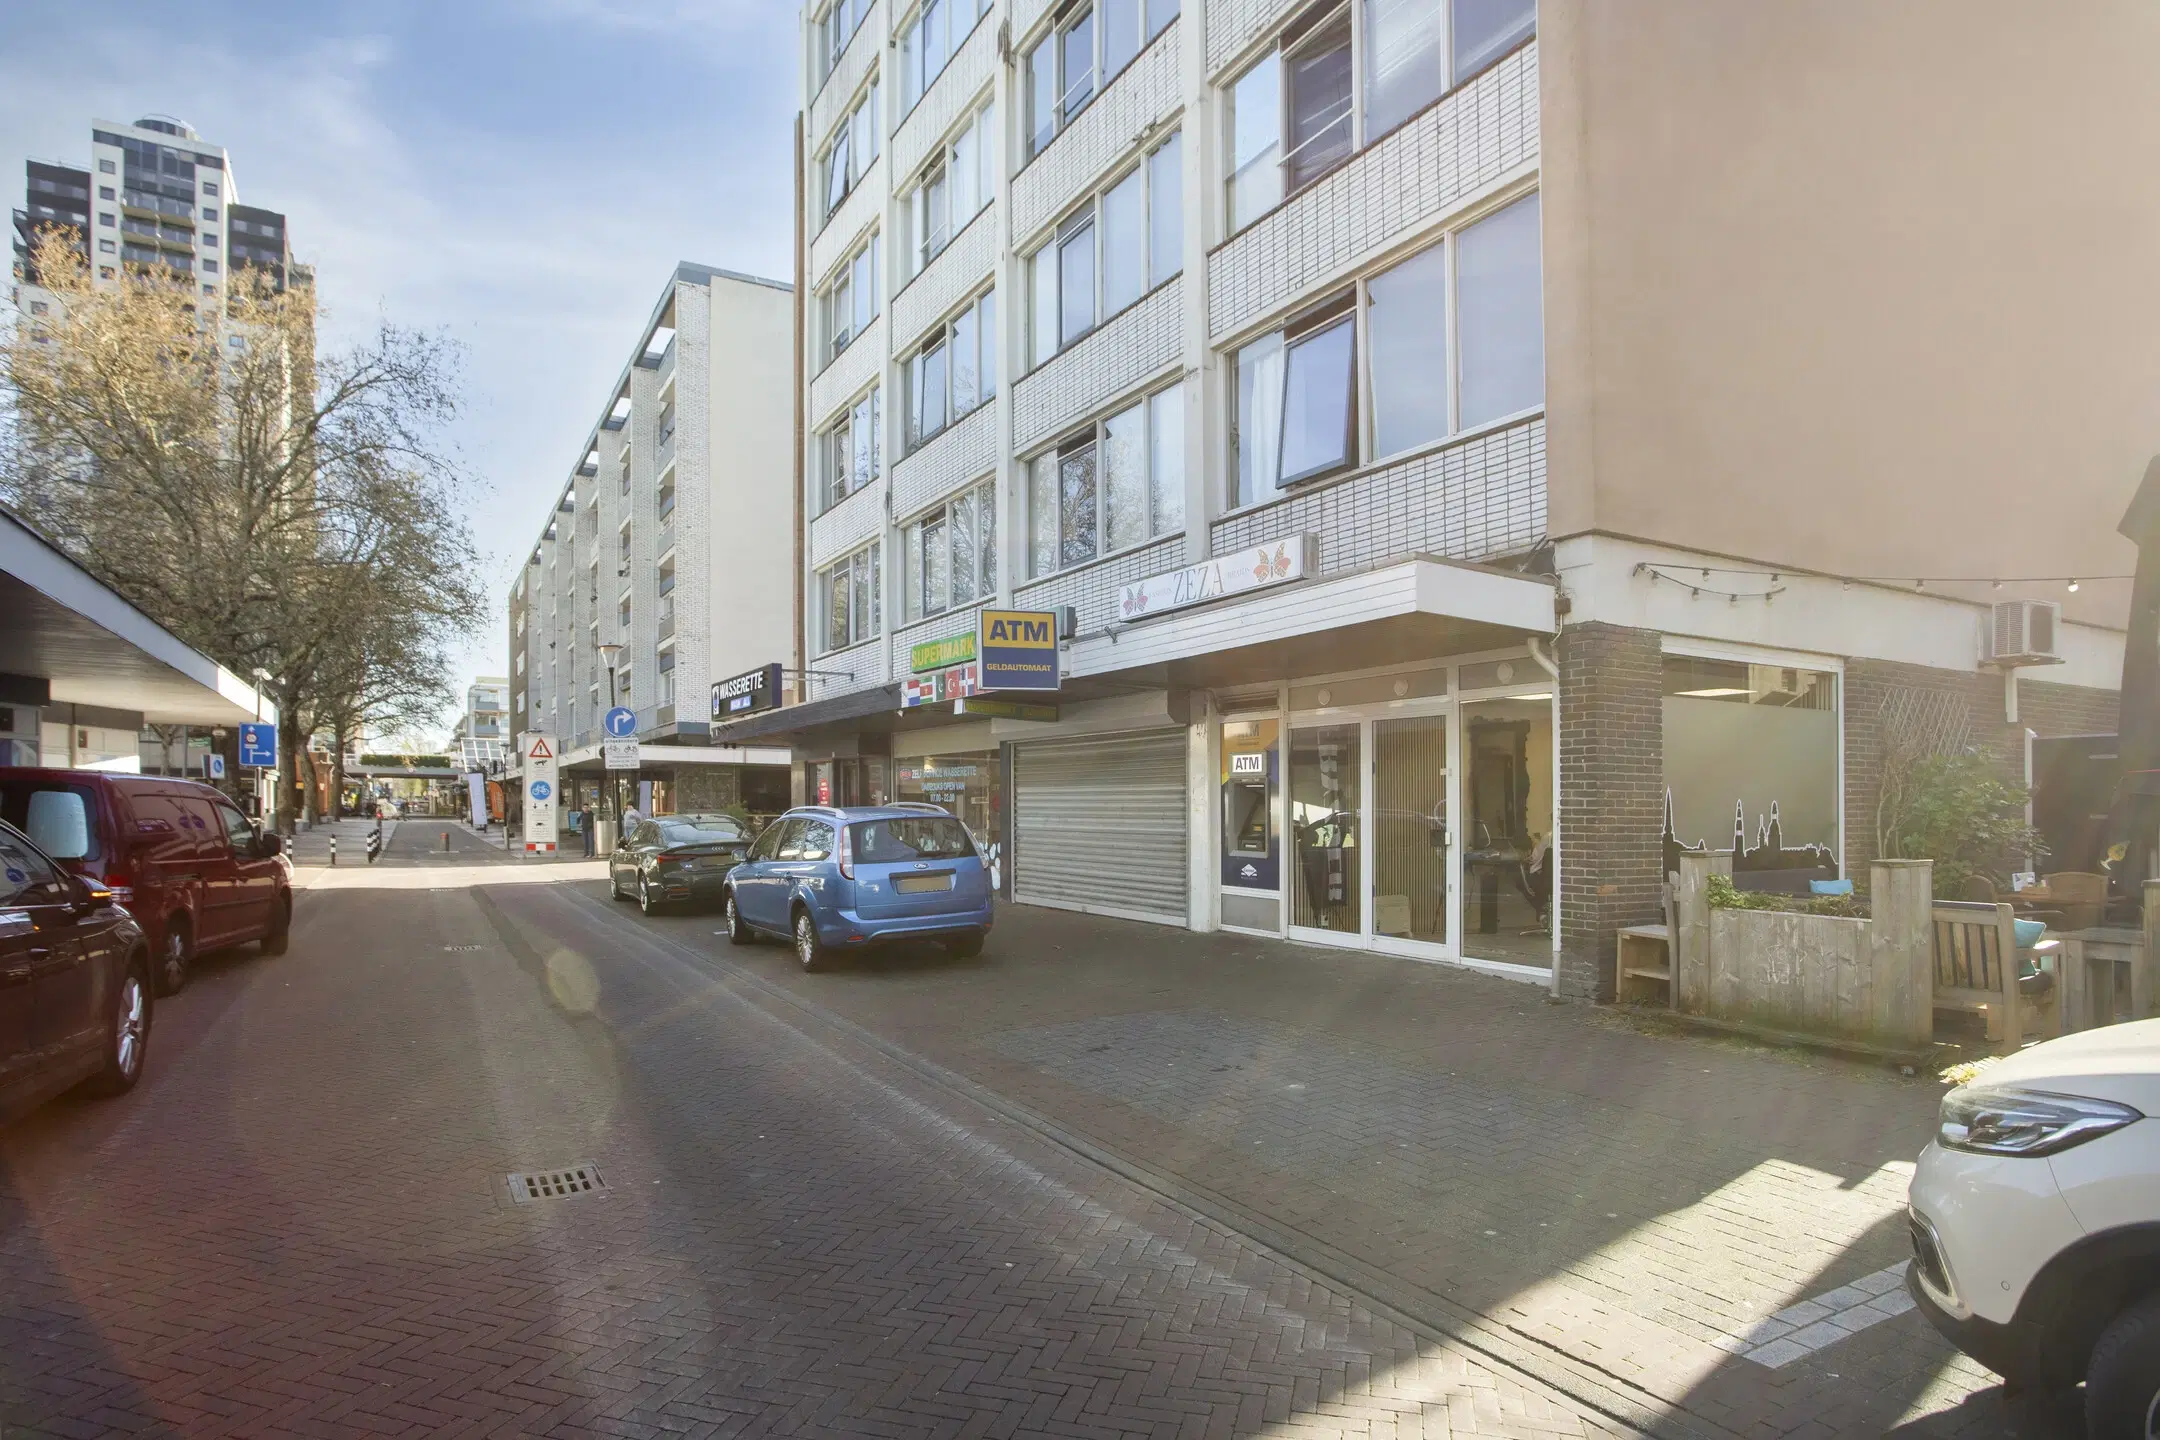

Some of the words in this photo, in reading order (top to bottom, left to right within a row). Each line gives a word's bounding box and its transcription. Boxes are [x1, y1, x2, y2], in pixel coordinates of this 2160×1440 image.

[1173, 562, 1224, 604] ZEZA
[989, 620, 1048, 642] ATM
[912, 636, 976, 667] SUPERMARK
[986, 663, 1052, 672] GELDAUTOMAAT
[720, 671, 763, 699] WASSERETTE
[1235, 757, 1259, 770] ATM
